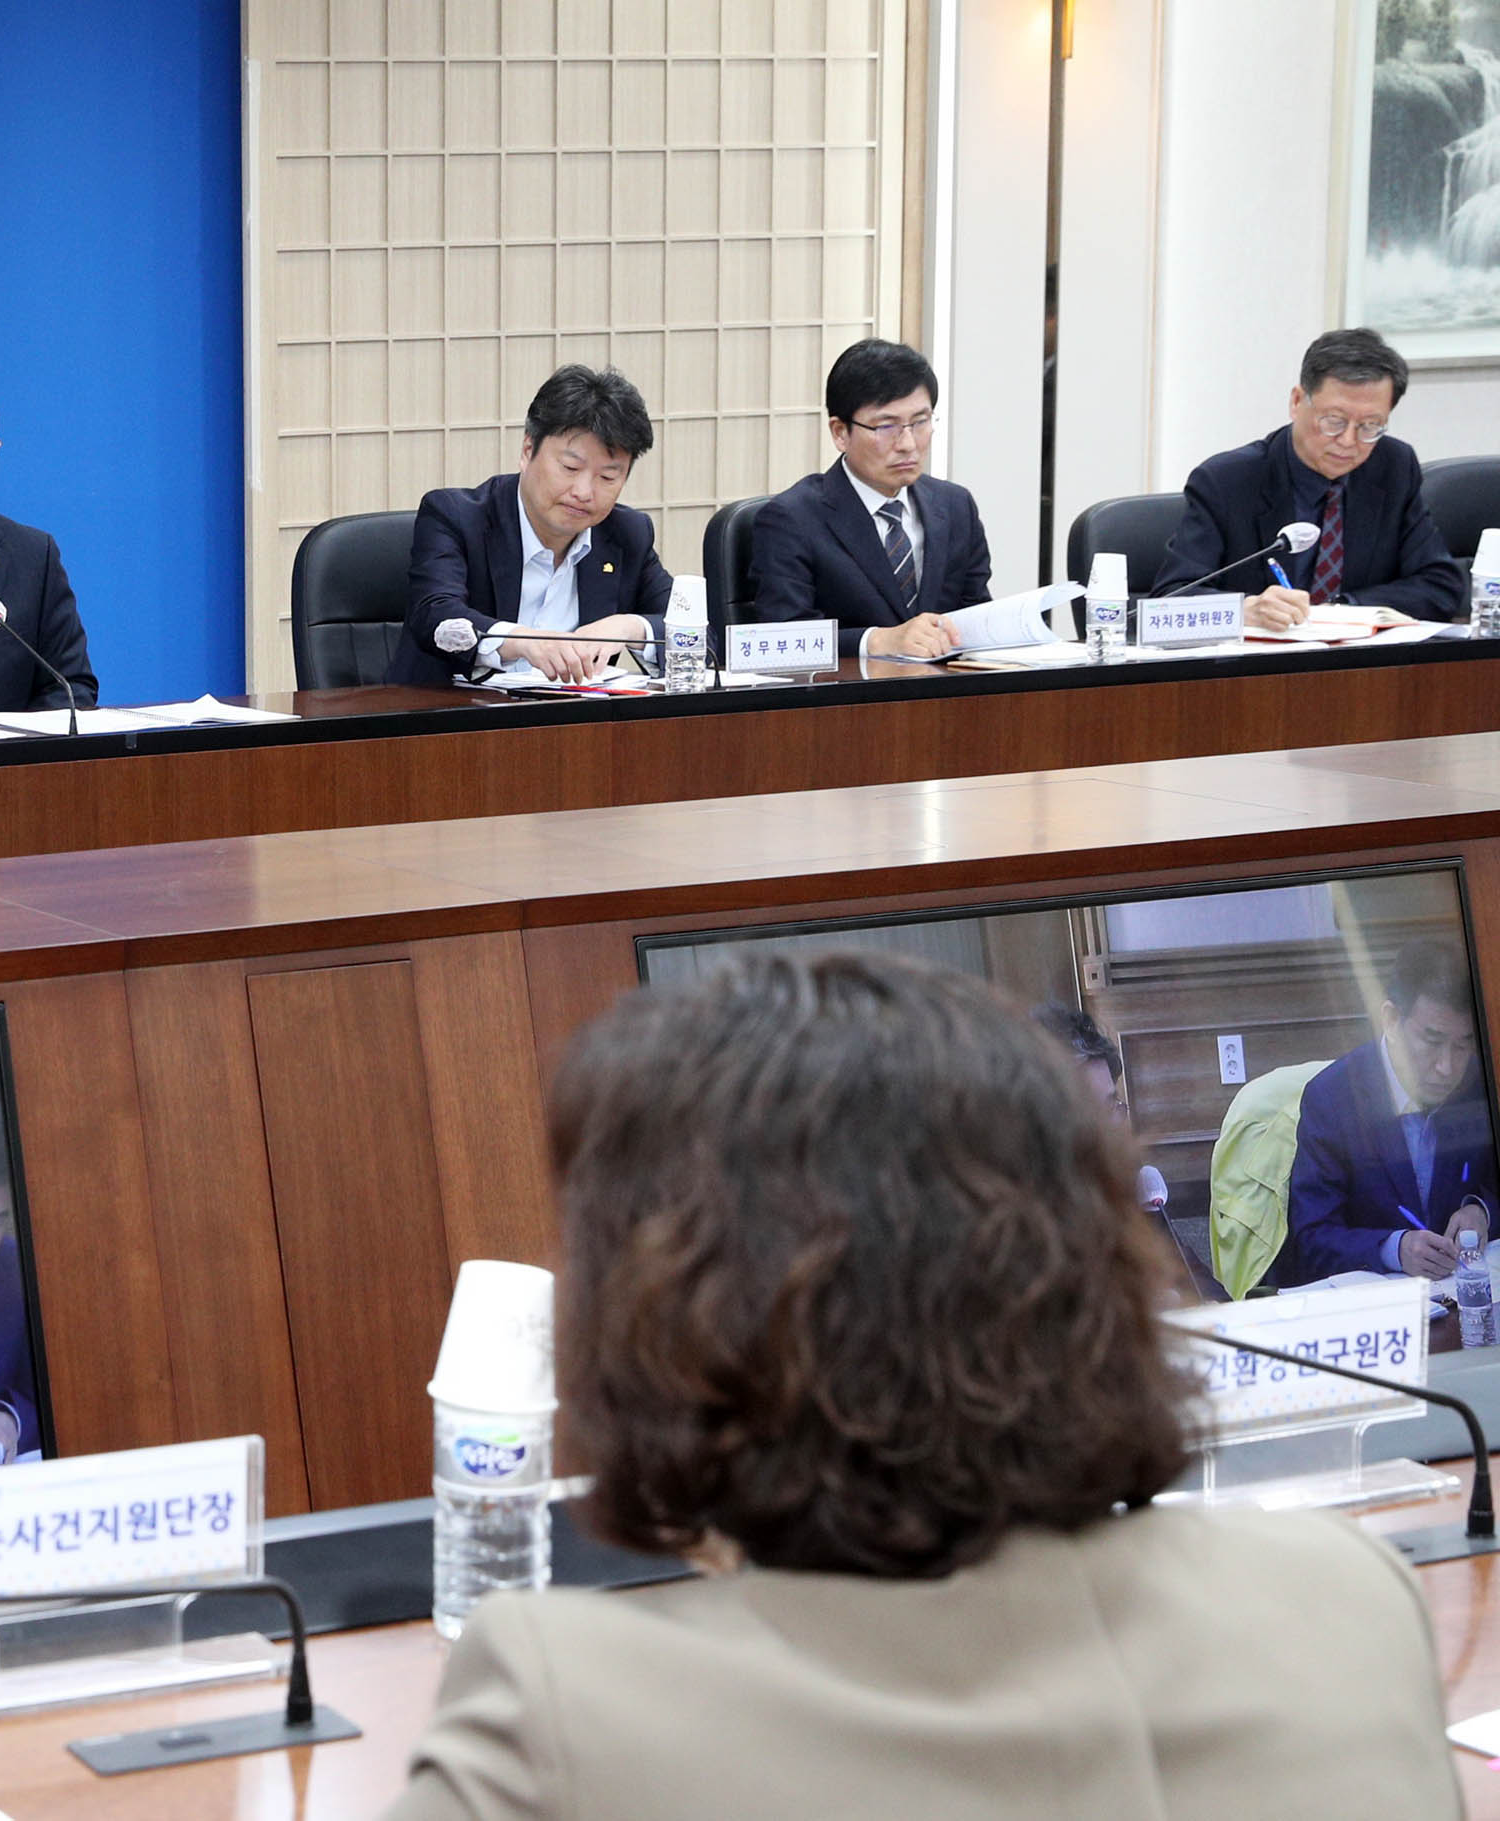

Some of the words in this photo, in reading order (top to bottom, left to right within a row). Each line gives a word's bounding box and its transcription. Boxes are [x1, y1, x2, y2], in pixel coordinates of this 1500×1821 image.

[1149, 610, 1235, 629] 자치경찰위원장
[740, 640, 826, 657] 정무부지사
[1172, 1327, 1412, 1393] 건환경연구원장
